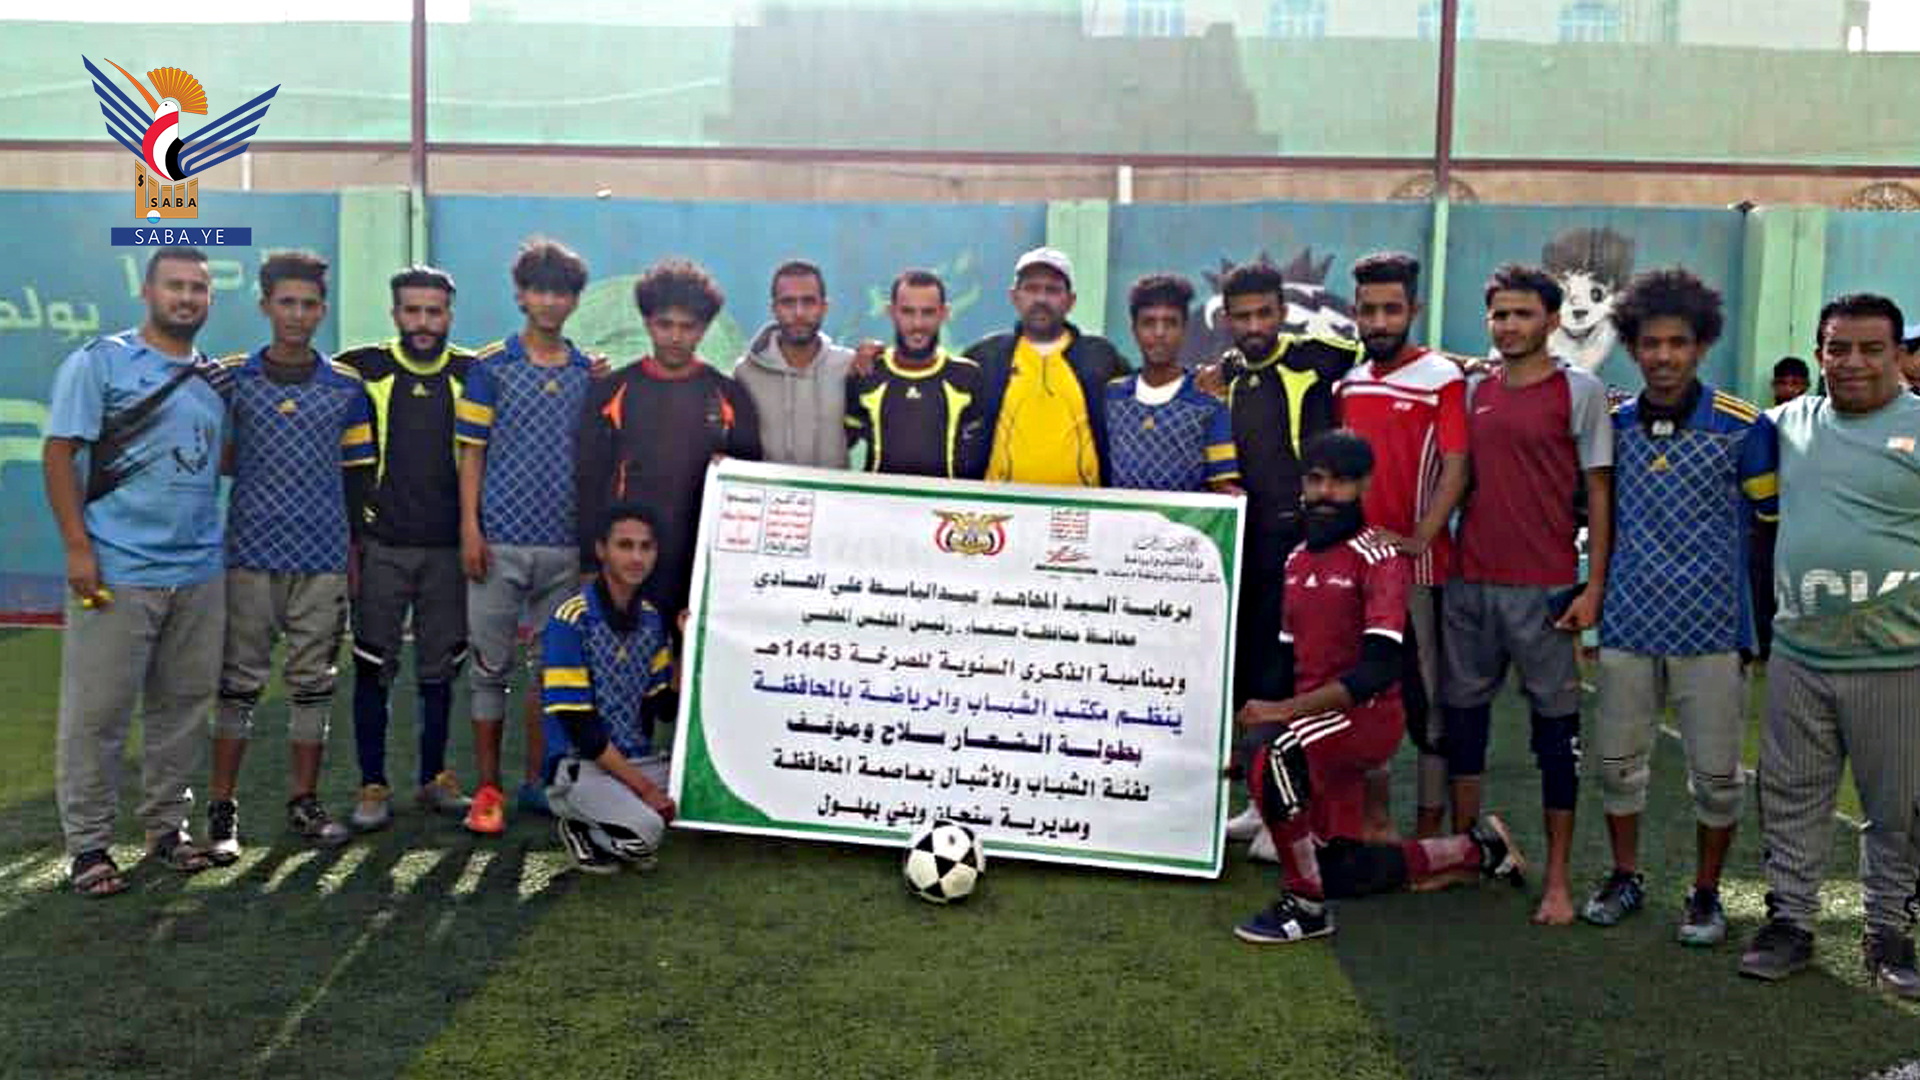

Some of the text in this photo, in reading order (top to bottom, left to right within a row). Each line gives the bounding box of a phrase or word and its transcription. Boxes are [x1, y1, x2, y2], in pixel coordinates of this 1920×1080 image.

[850, 643, 932, 671] للصرخة
[940, 650, 1015, 678] السنوية
[1020, 661, 1092, 682] الذكرى
[1099, 663, 1186, 695] وبمناسبة
[753, 670, 1182, 735] ينظم مكتب الشباب والرياضة بالمحافظة
[787, 711, 1142, 767] بطولة الشعار سلاح وموقف
[773, 748, 851, 774] المحافظة
[858, 755, 935, 789] بعاصمة
[1027, 771, 1095, 799] الشباب
[817, 793, 881, 822] بهلول
[931, 805, 992, 827] سنحان
[1000, 806, 1091, 840] ومديرية
